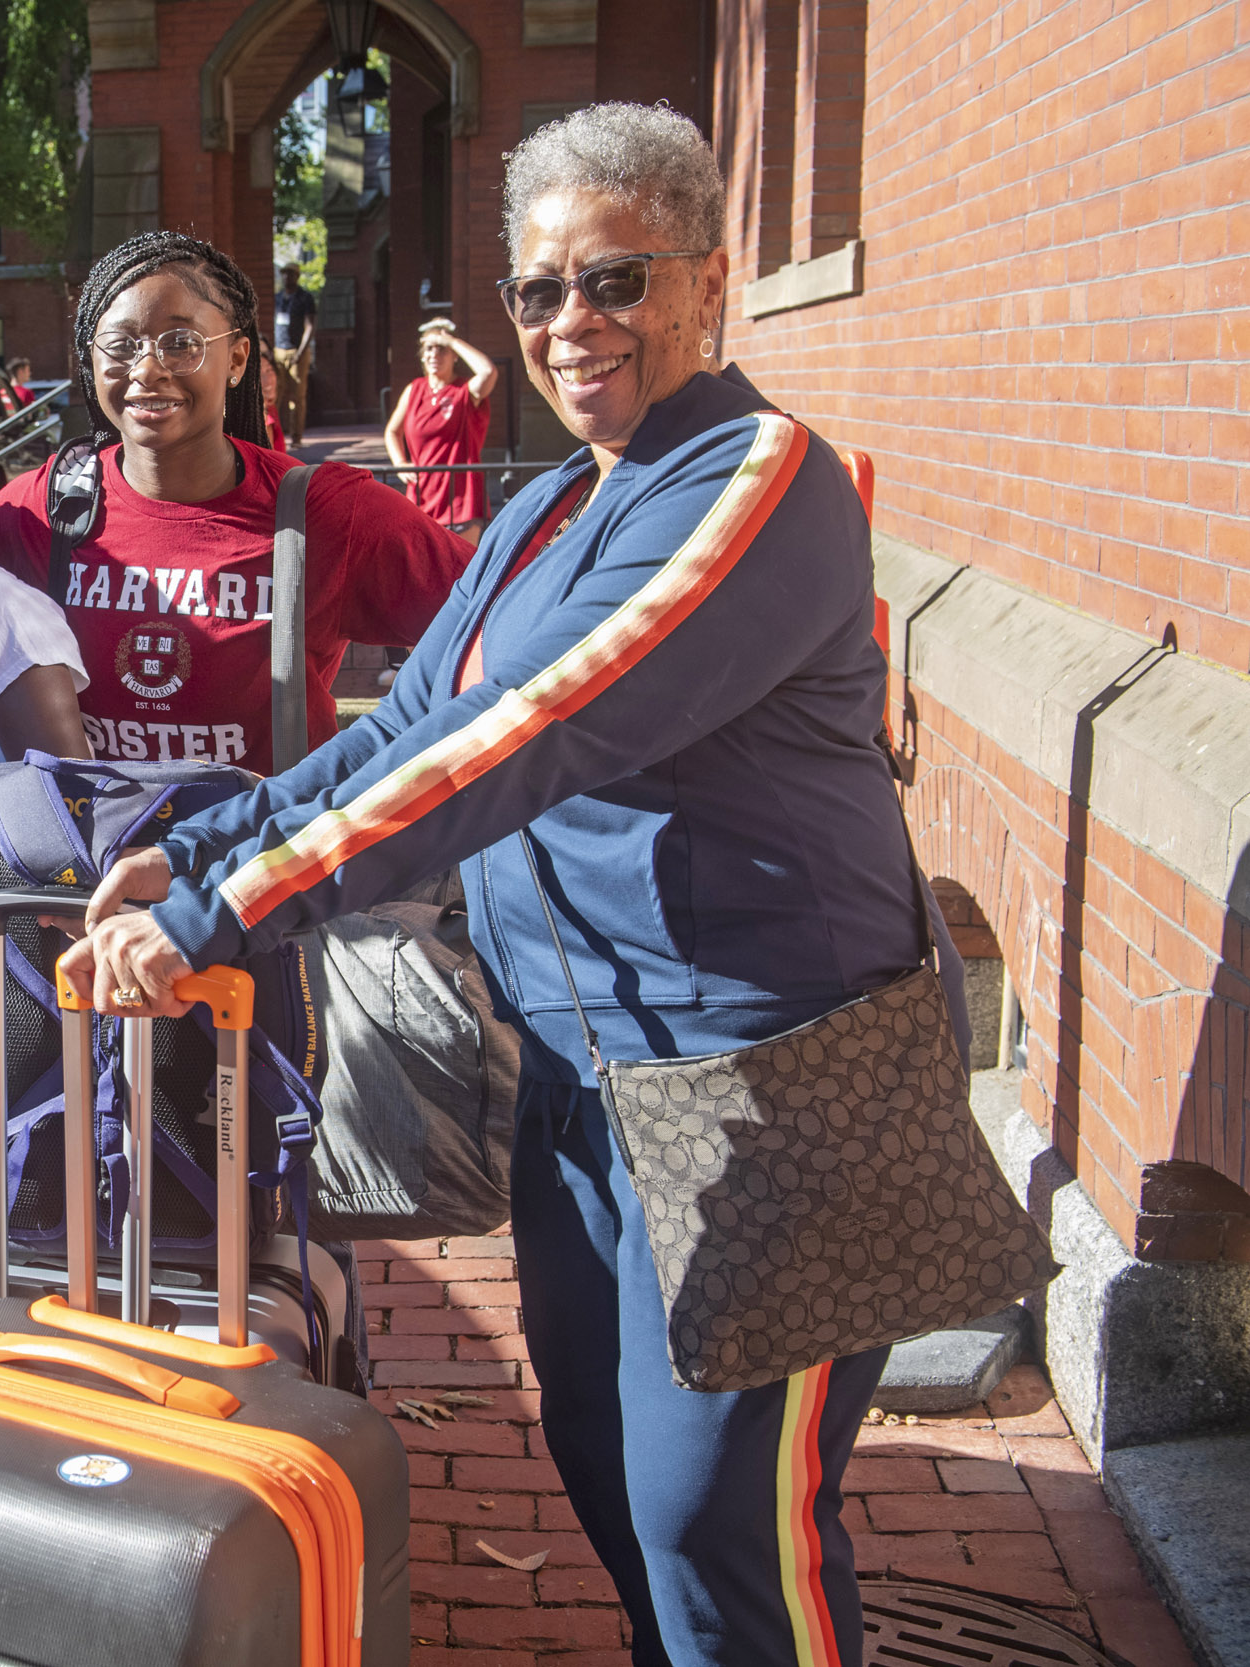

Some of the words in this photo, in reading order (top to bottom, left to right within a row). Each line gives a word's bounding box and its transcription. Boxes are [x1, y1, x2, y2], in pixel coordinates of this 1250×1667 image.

[130, 682, 172, 698] HARVARD
[135, 701, 150, 710] EST.
[151, 702, 171, 711] 1636
[81, 712, 248, 763] SISTER
[304, 1003, 317, 1051] BALANCE
[303, 1053, 316, 1078] NEW
